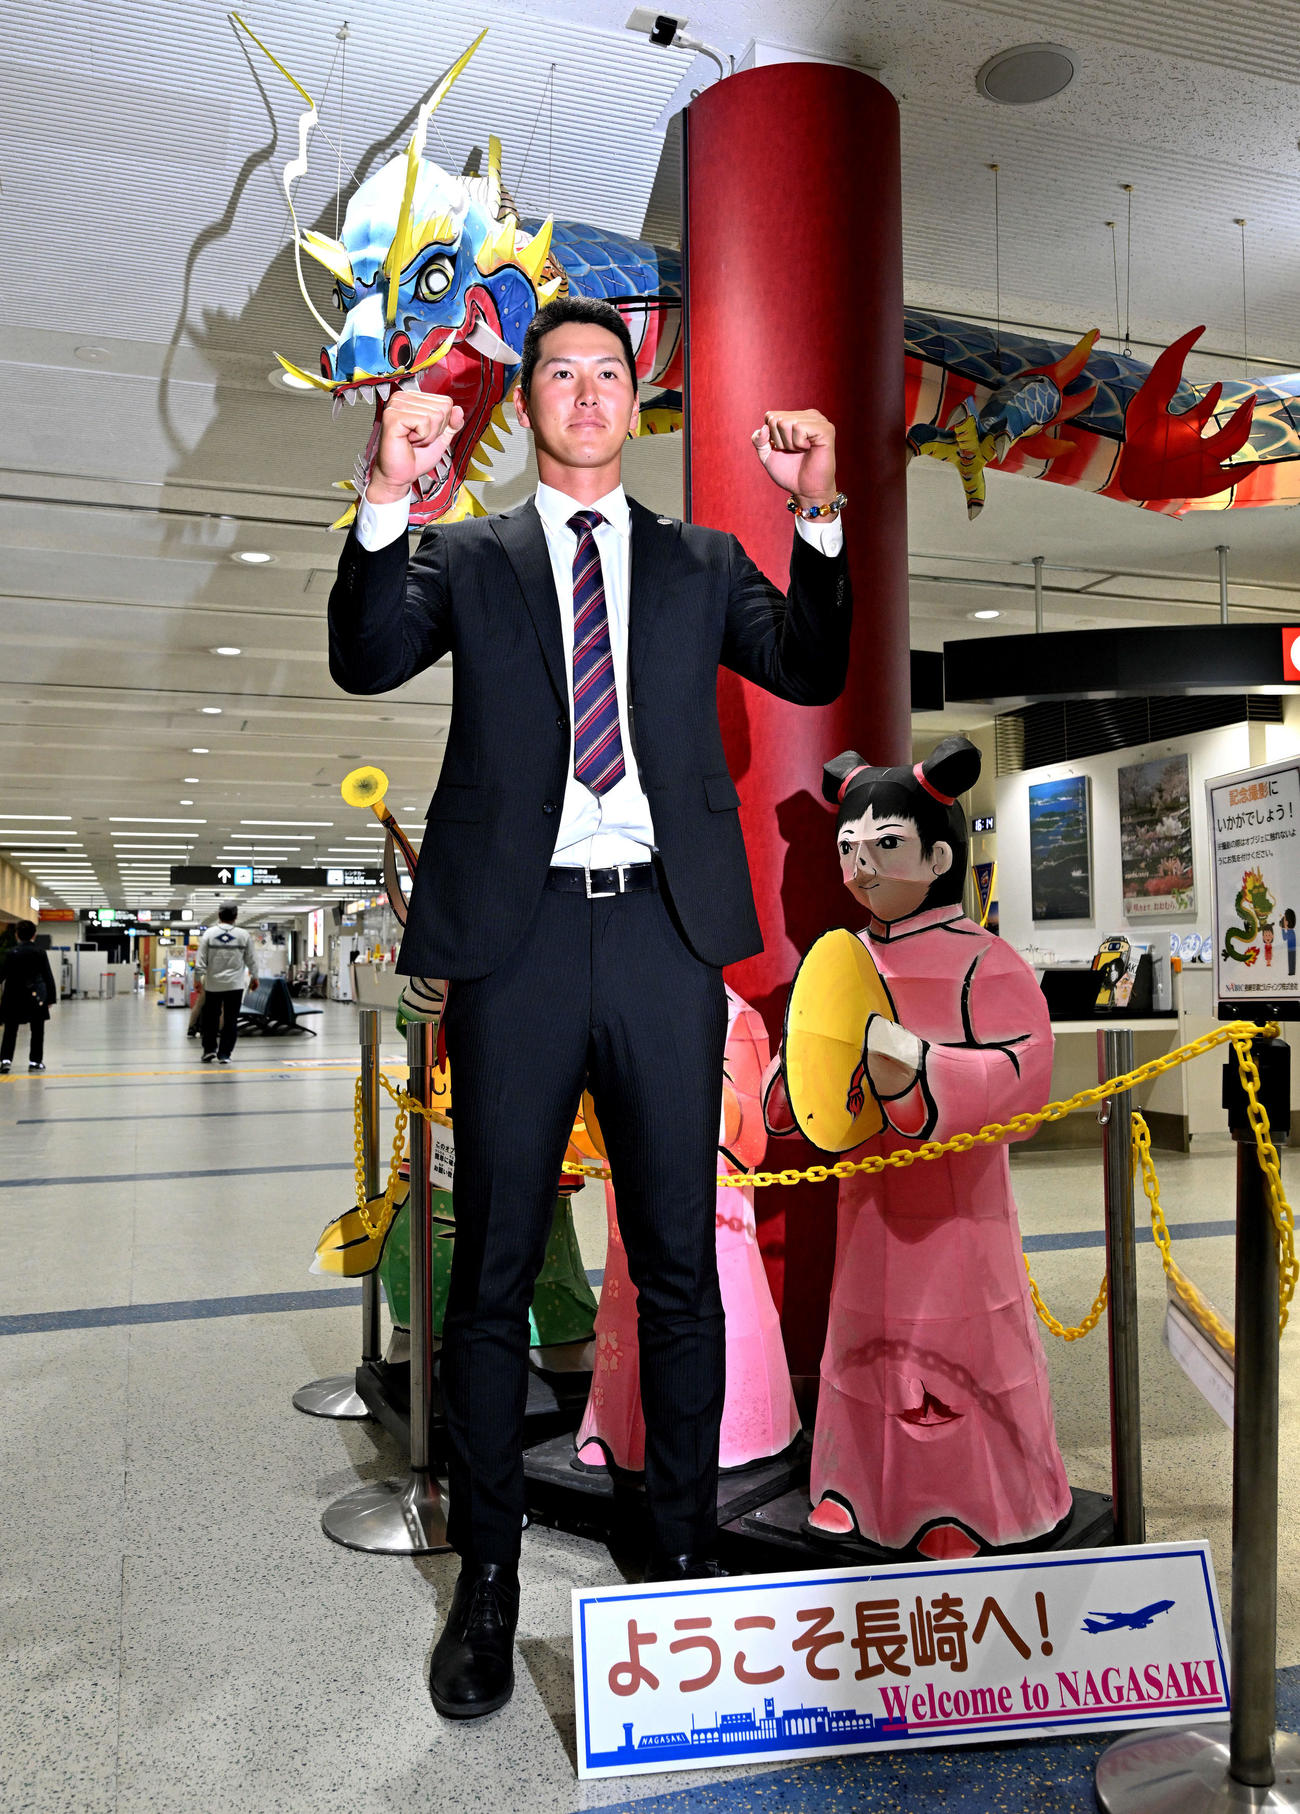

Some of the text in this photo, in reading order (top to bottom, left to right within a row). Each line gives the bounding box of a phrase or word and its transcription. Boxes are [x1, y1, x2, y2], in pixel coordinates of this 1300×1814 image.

[1228, 781, 1279, 806] 記念撮影に
[975, 818, 993, 831] 16:14
[1217, 801, 1293, 832] いかがでしょう！
[608, 1591, 1053, 1696] ようこそ長崎へ！
[878, 1660, 1221, 1724] Welcome to NAGASAKI
[641, 1734, 687, 1745] NAGASAKI
